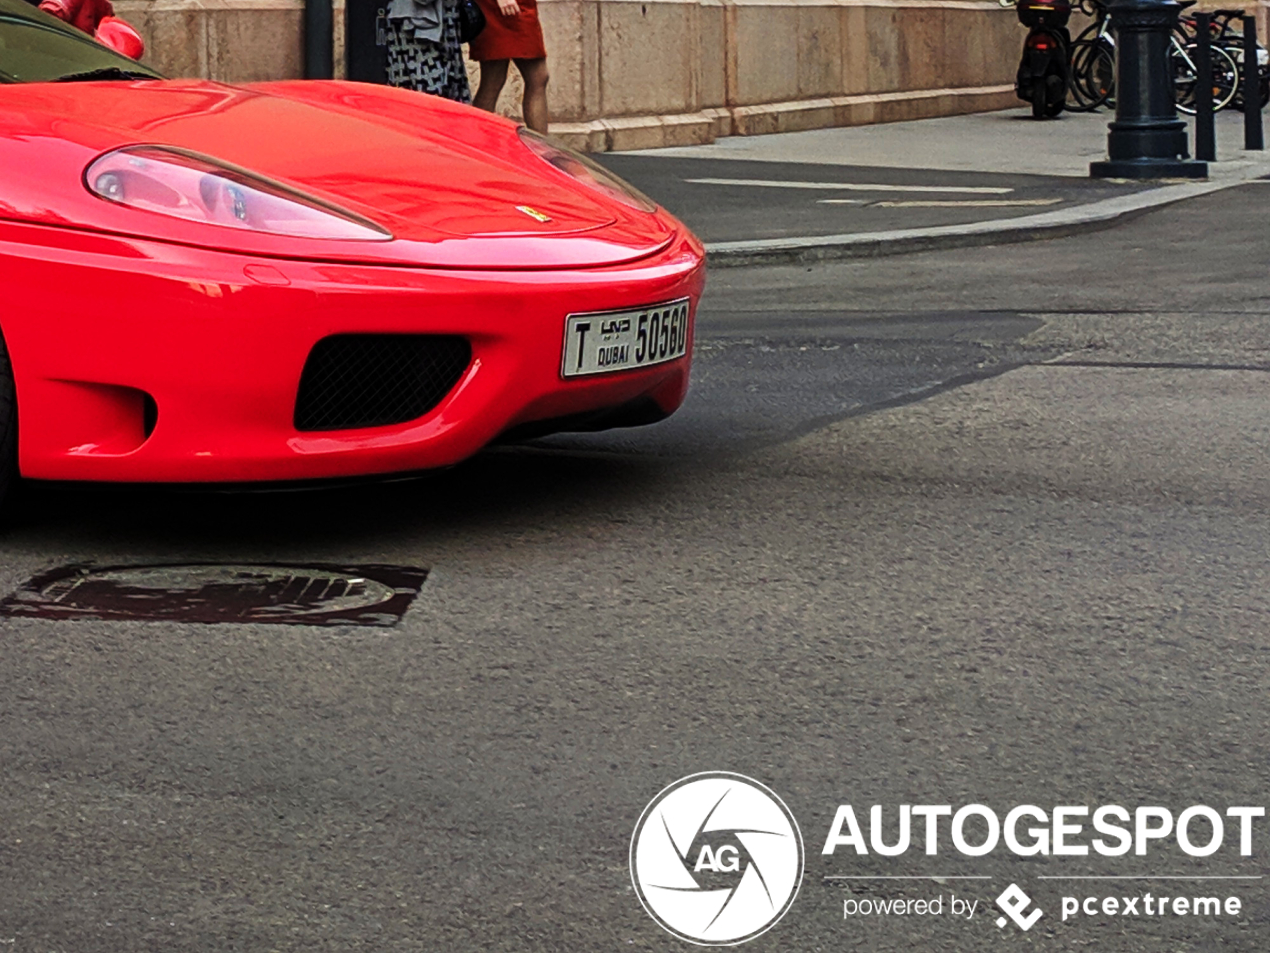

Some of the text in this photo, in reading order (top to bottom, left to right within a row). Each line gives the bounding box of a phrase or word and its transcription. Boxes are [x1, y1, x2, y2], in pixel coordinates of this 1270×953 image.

[575, 323, 591, 368] T
[598, 345, 629, 366] DUBAI
[635, 306, 687, 363] 50560
